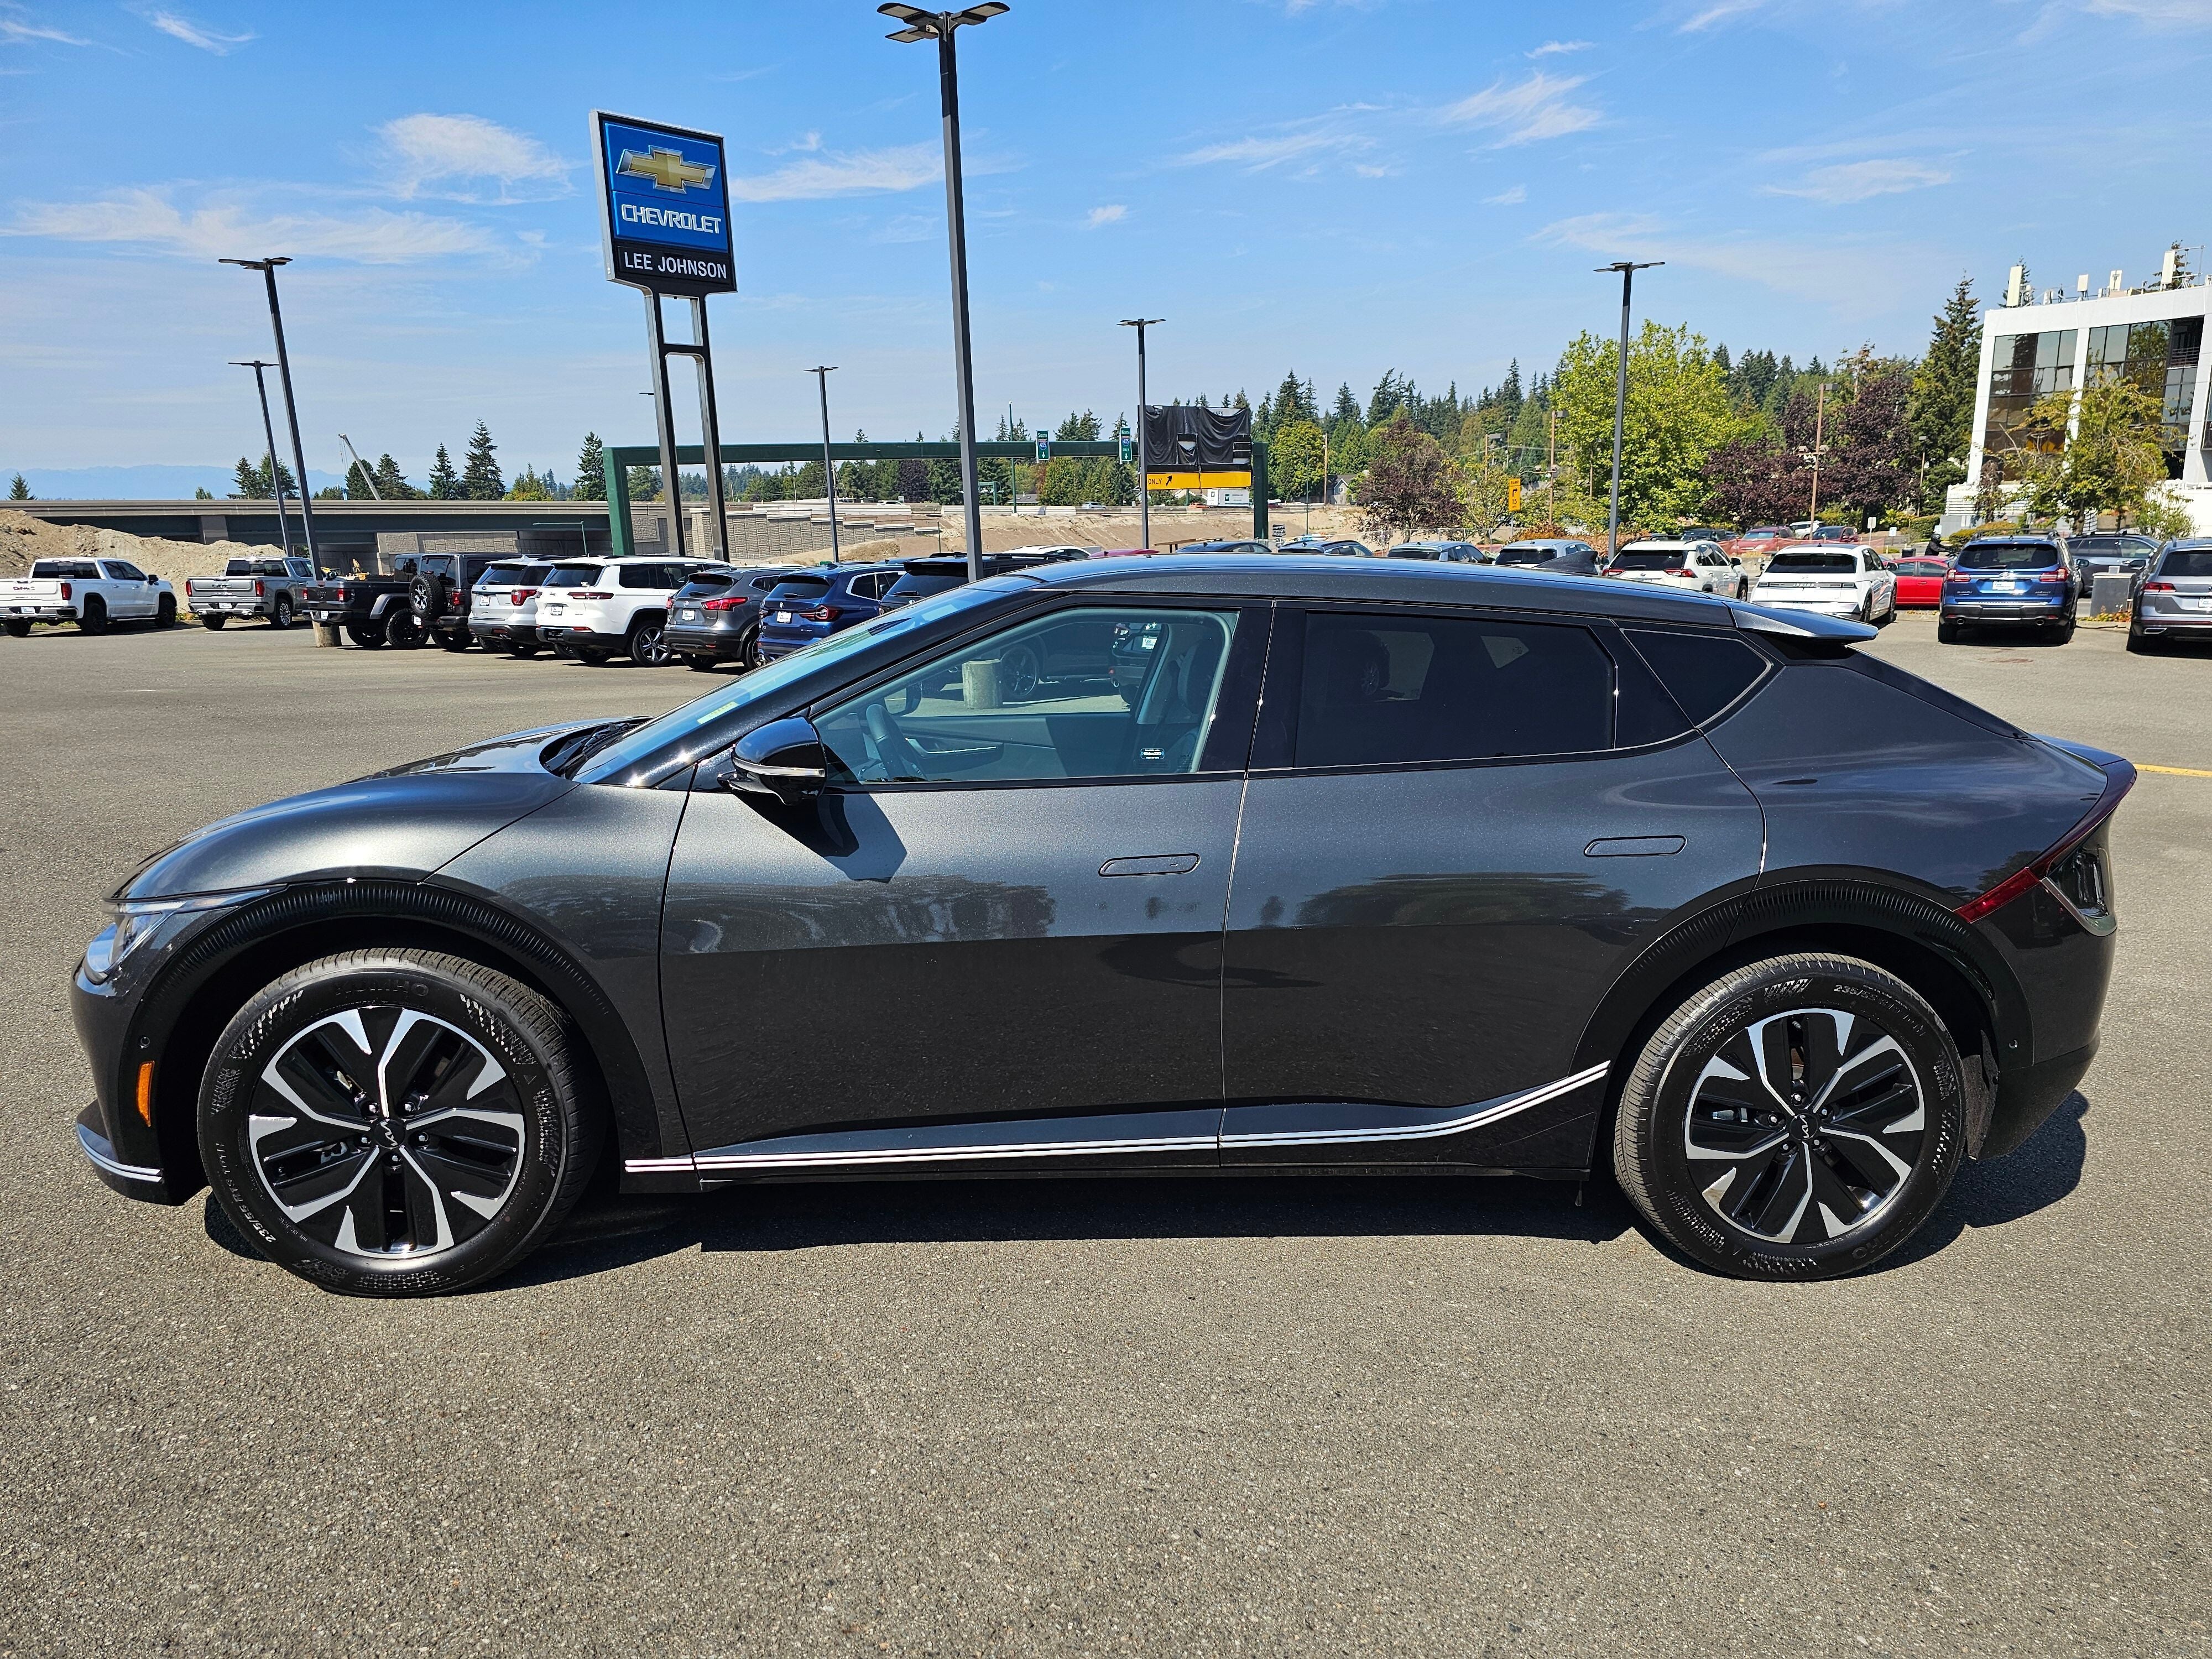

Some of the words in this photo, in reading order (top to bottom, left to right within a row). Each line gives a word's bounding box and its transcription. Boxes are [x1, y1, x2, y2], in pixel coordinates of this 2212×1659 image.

[621, 204, 721, 234] CHEVROLET
[624, 252, 653, 270] LEE
[658, 256, 727, 279] JOHNSON
[239, 1204, 276, 1243] 235/55
